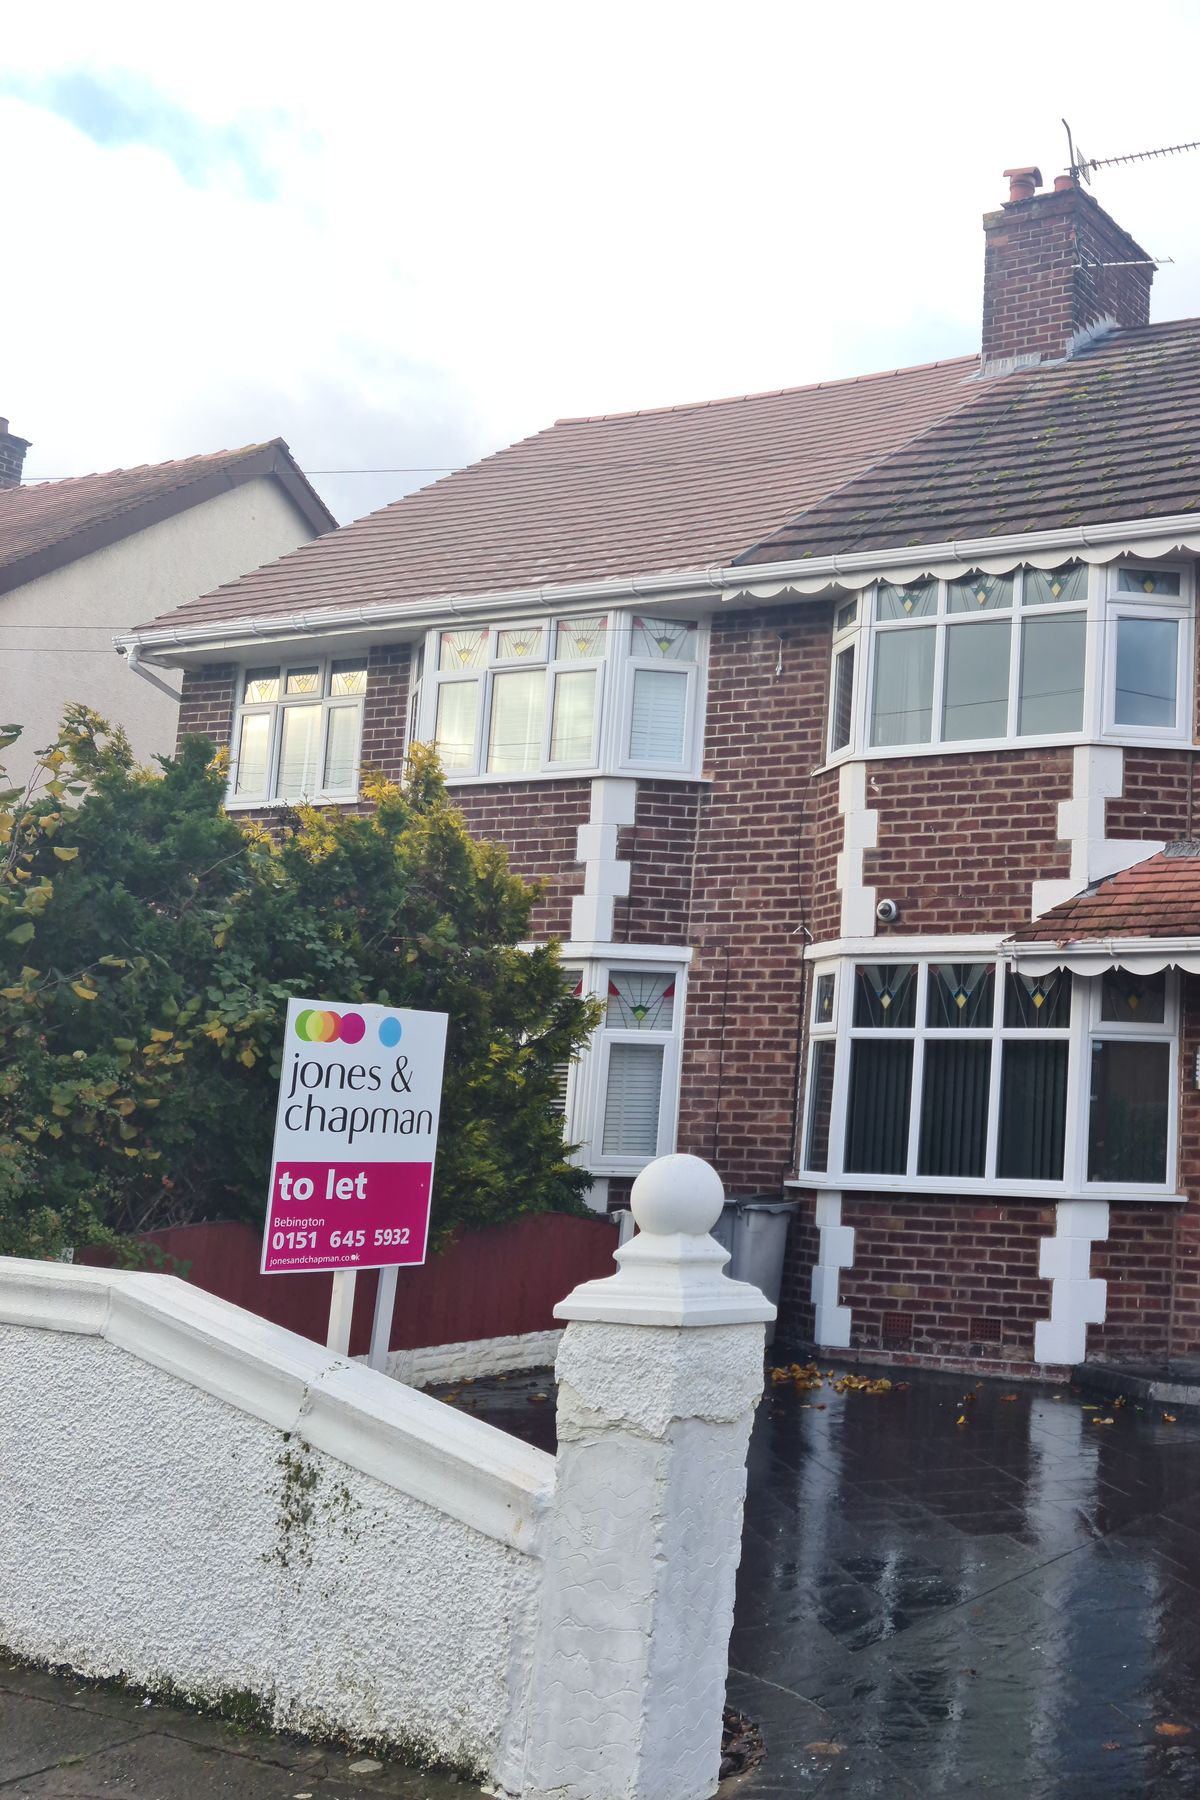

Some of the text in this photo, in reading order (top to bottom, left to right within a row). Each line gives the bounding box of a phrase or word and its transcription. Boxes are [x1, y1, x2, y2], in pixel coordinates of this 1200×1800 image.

[288, 1052, 413, 1098] jones &
[284, 1094, 433, 1144] chapman
[278, 1168, 368, 1201] to let
[274, 1217, 325, 1229] Bebington
[272, 1227, 410, 1249] 0151 645 5932
[269, 1253, 360, 1266] jonesandchapman.co.k
